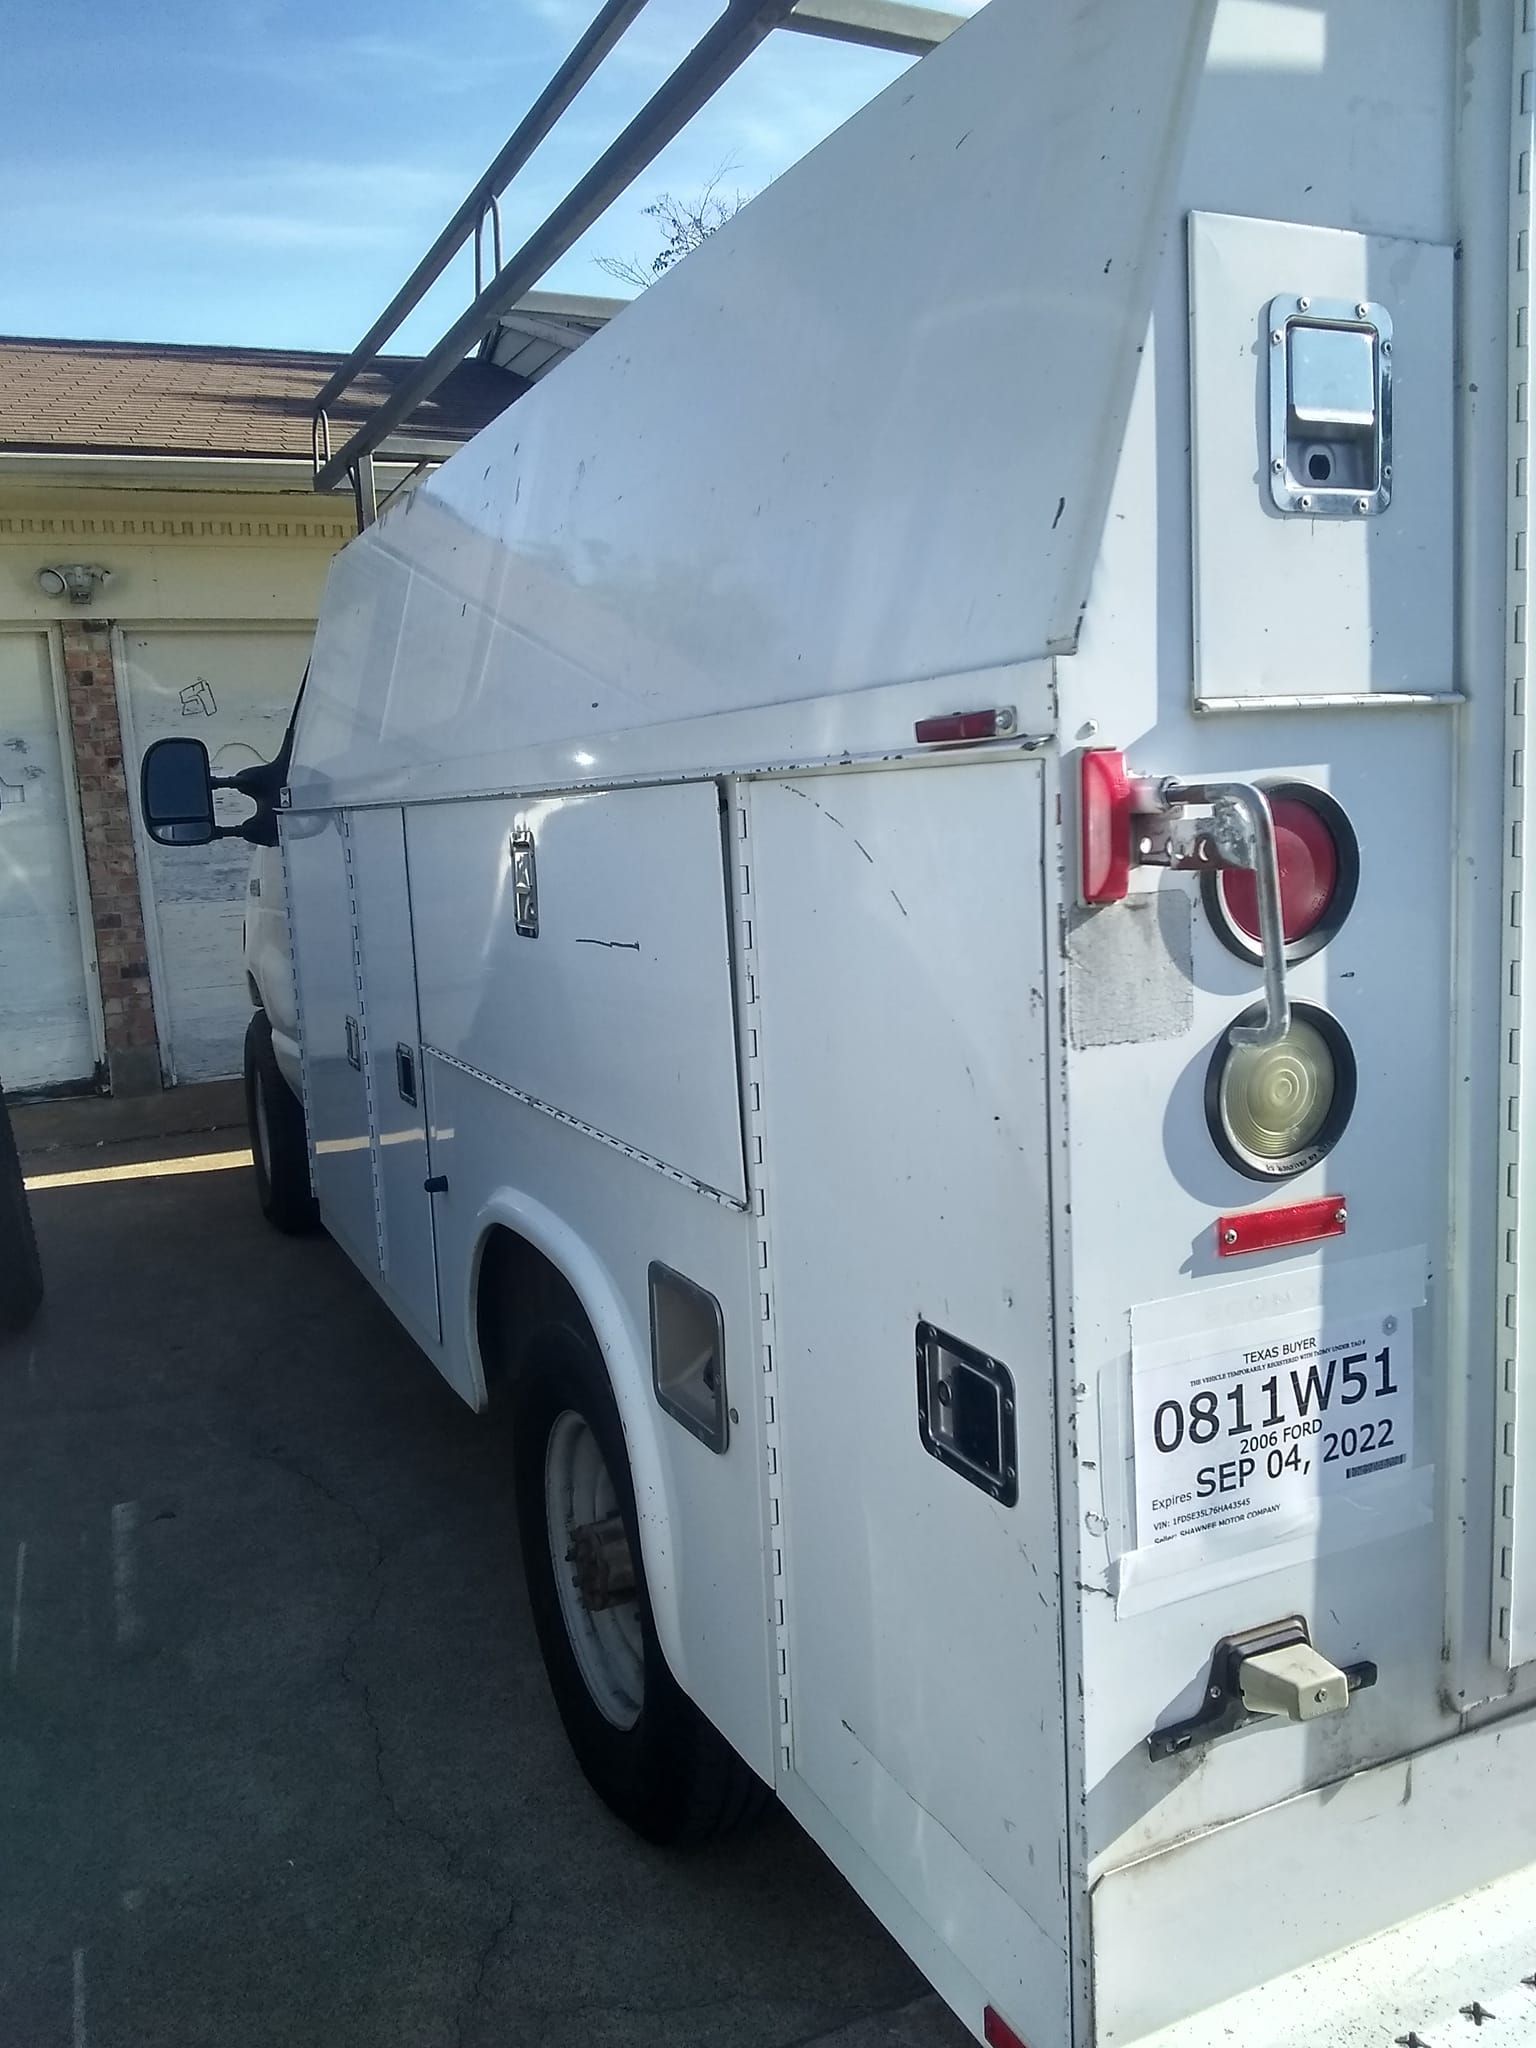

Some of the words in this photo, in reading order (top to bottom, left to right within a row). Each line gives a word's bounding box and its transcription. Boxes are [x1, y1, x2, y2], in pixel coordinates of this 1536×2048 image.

[1242, 1346, 1279, 1364] TEXAS
[1282, 1336, 1317, 1356] BUYER
[1202, 1373, 1226, 1384] VEHICLE
[1227, 1364, 1266, 1378] TEMPORARILY
[1153, 1346, 1398, 1453] 0811W51
[1239, 1431, 1278, 1455] 2006
[1283, 1418, 1323, 1443] FORD
[1151, 1491, 1193, 1511] Expires
[1196, 1457, 1256, 1498] SEP
[1266, 1443, 1311, 1479] 04,
[1323, 1418, 1394, 1463] 2022
[1153, 1521, 1171, 1532] VIN:
[1218, 1513, 1246, 1528] MOTOR
[1246, 1503, 1281, 1520] COMPANY
